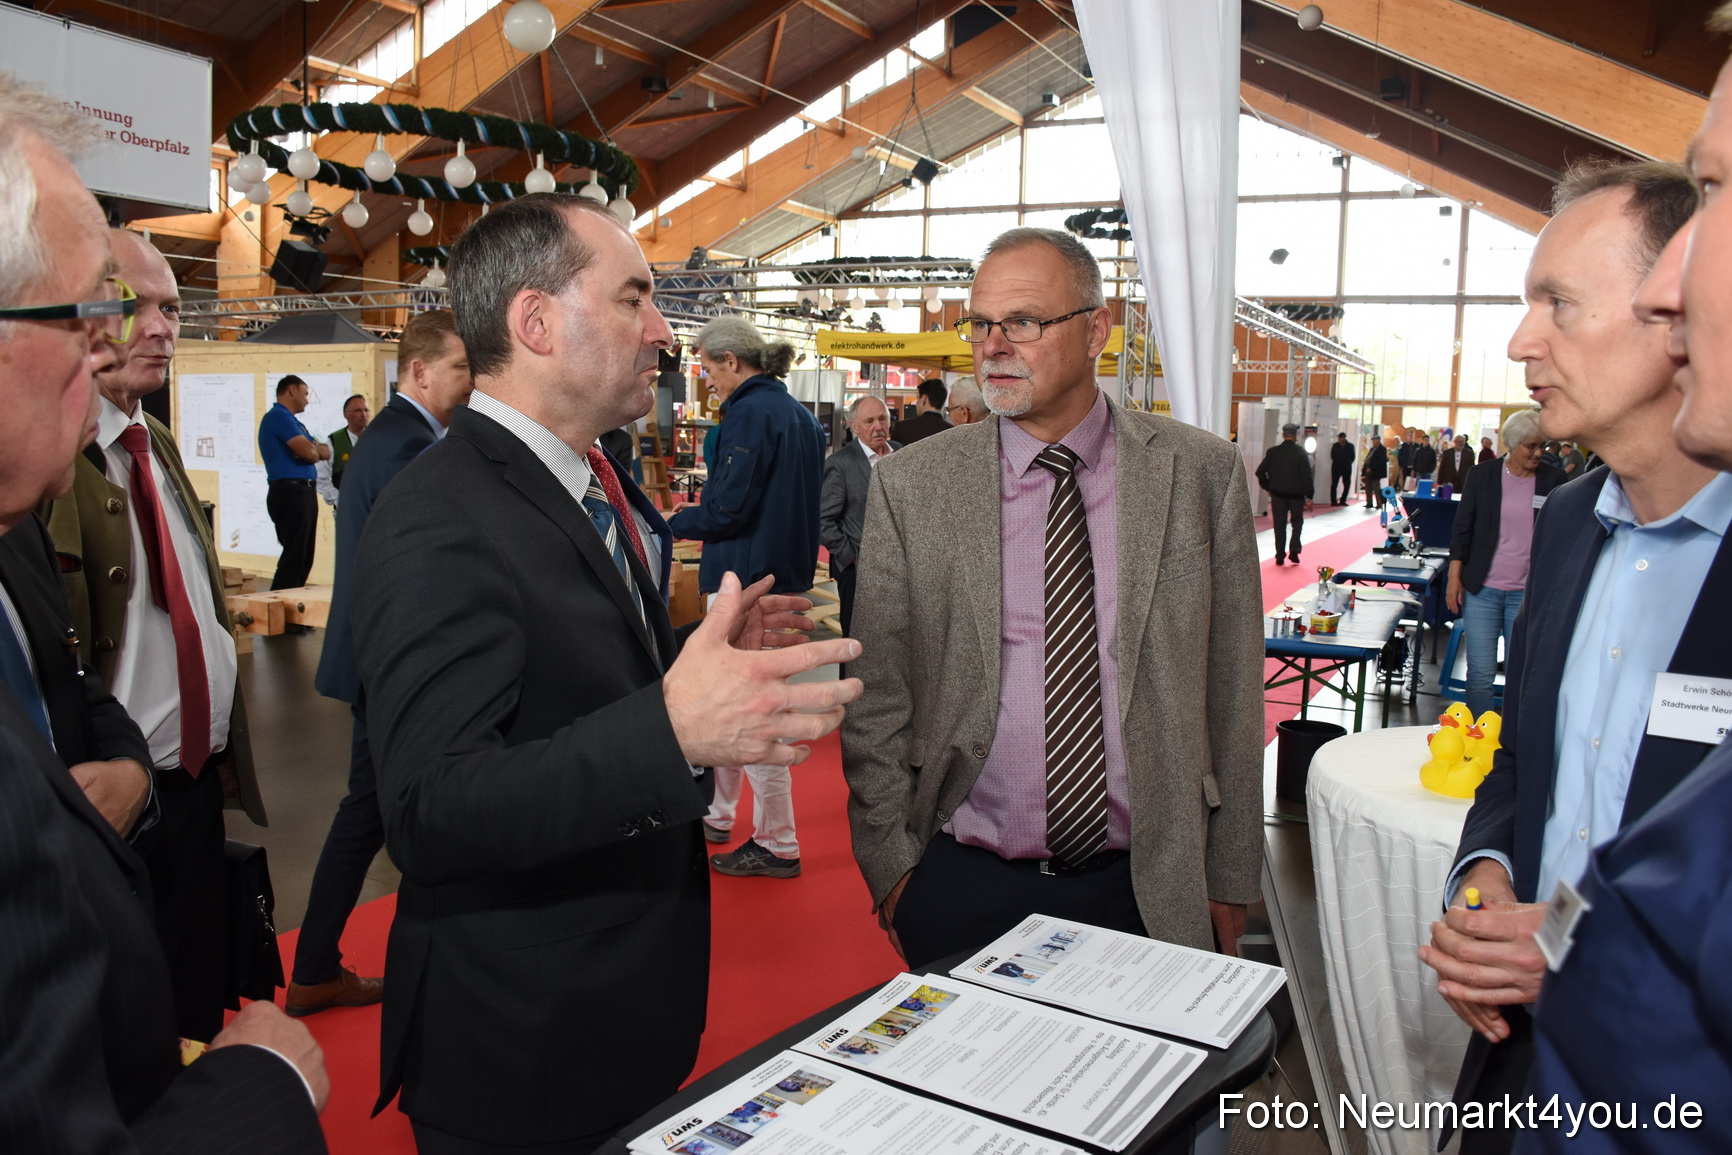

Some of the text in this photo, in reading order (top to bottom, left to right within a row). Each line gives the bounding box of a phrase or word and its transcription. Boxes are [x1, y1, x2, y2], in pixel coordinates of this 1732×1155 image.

[120, 130, 190, 155] Oberpfalz
[830, 341, 905, 350] elektrohandwerk.de
[1683, 685, 1708, 694] Erwin
[1661, 699, 1709, 712] Stadtwerke
[826, 1028, 849, 1043] swn
[672, 1117, 703, 1136] swn
